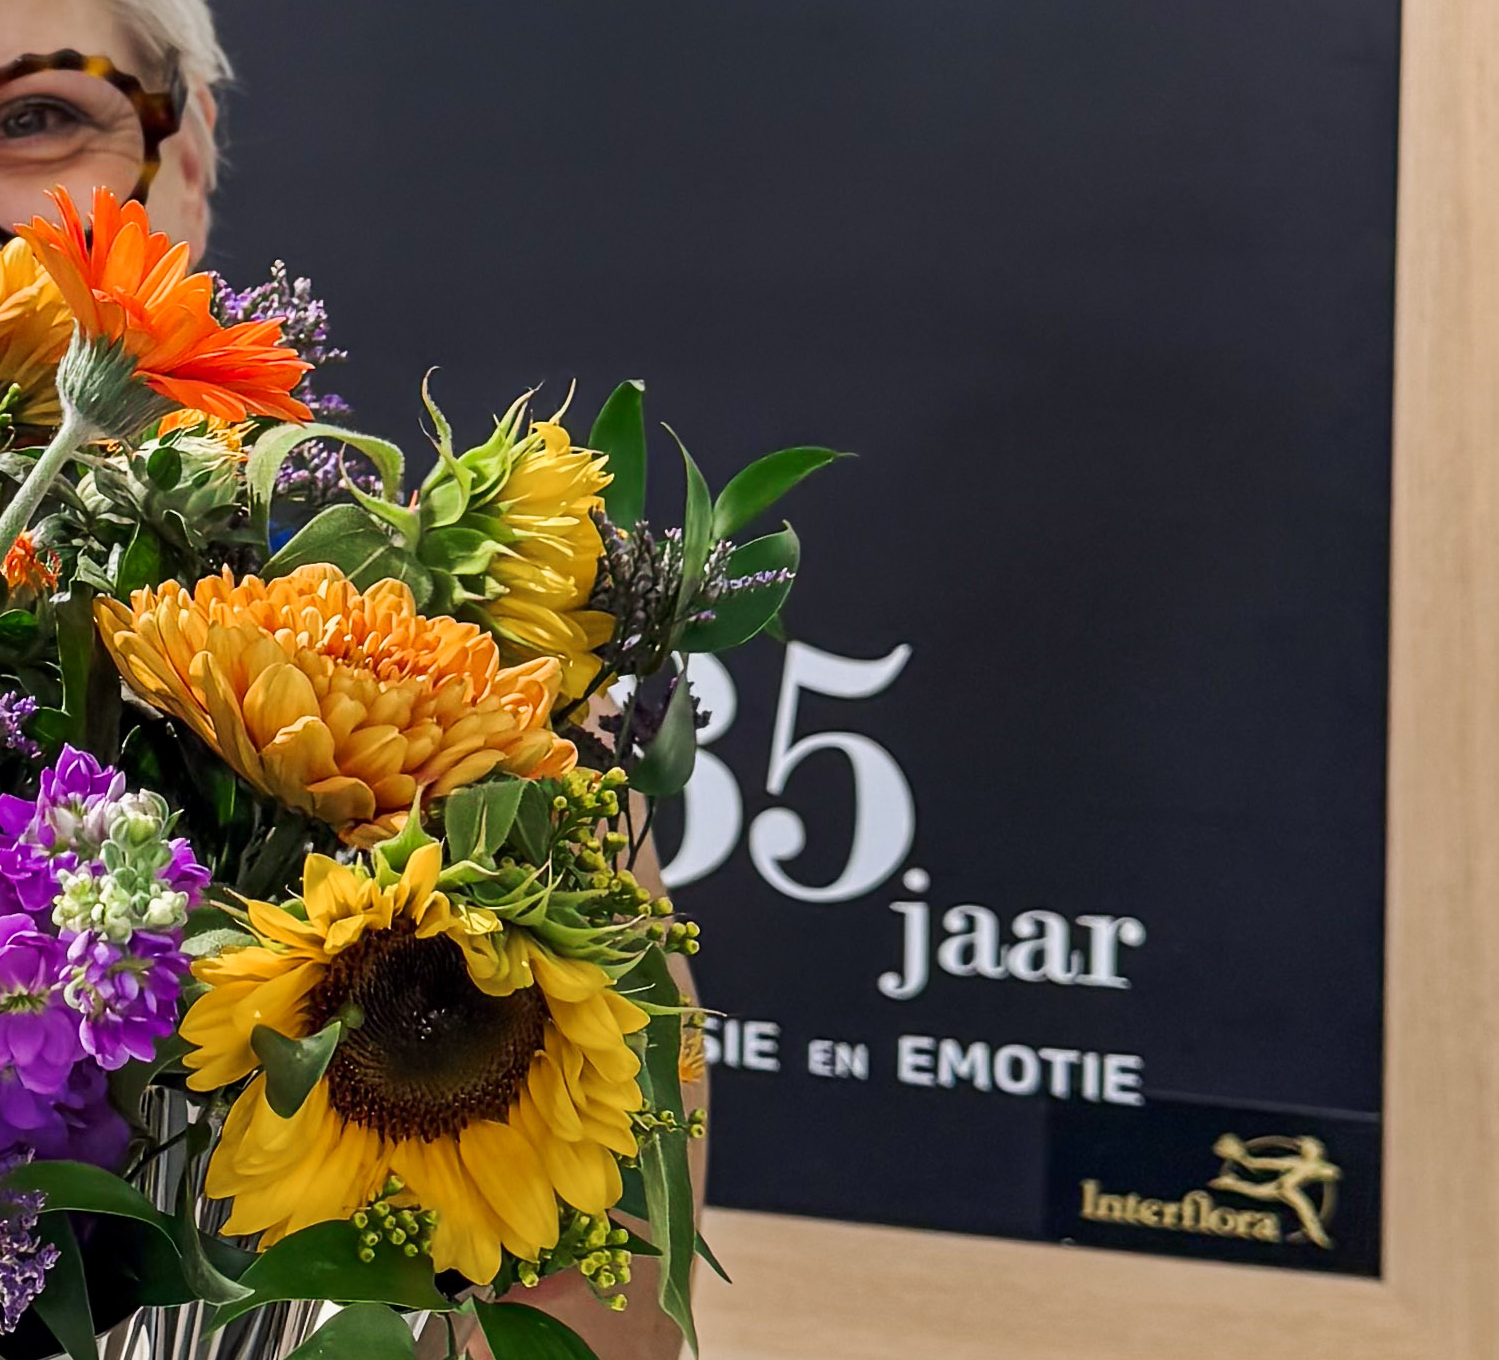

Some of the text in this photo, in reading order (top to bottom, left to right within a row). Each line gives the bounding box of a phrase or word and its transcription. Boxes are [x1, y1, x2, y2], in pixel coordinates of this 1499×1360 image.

[877, 868, 1146, 1001] jaar
[807, 1039, 869, 1081] EN
[898, 1034, 1145, 1107] EMOTIE
[1080, 1178, 1281, 1242] Interflora
